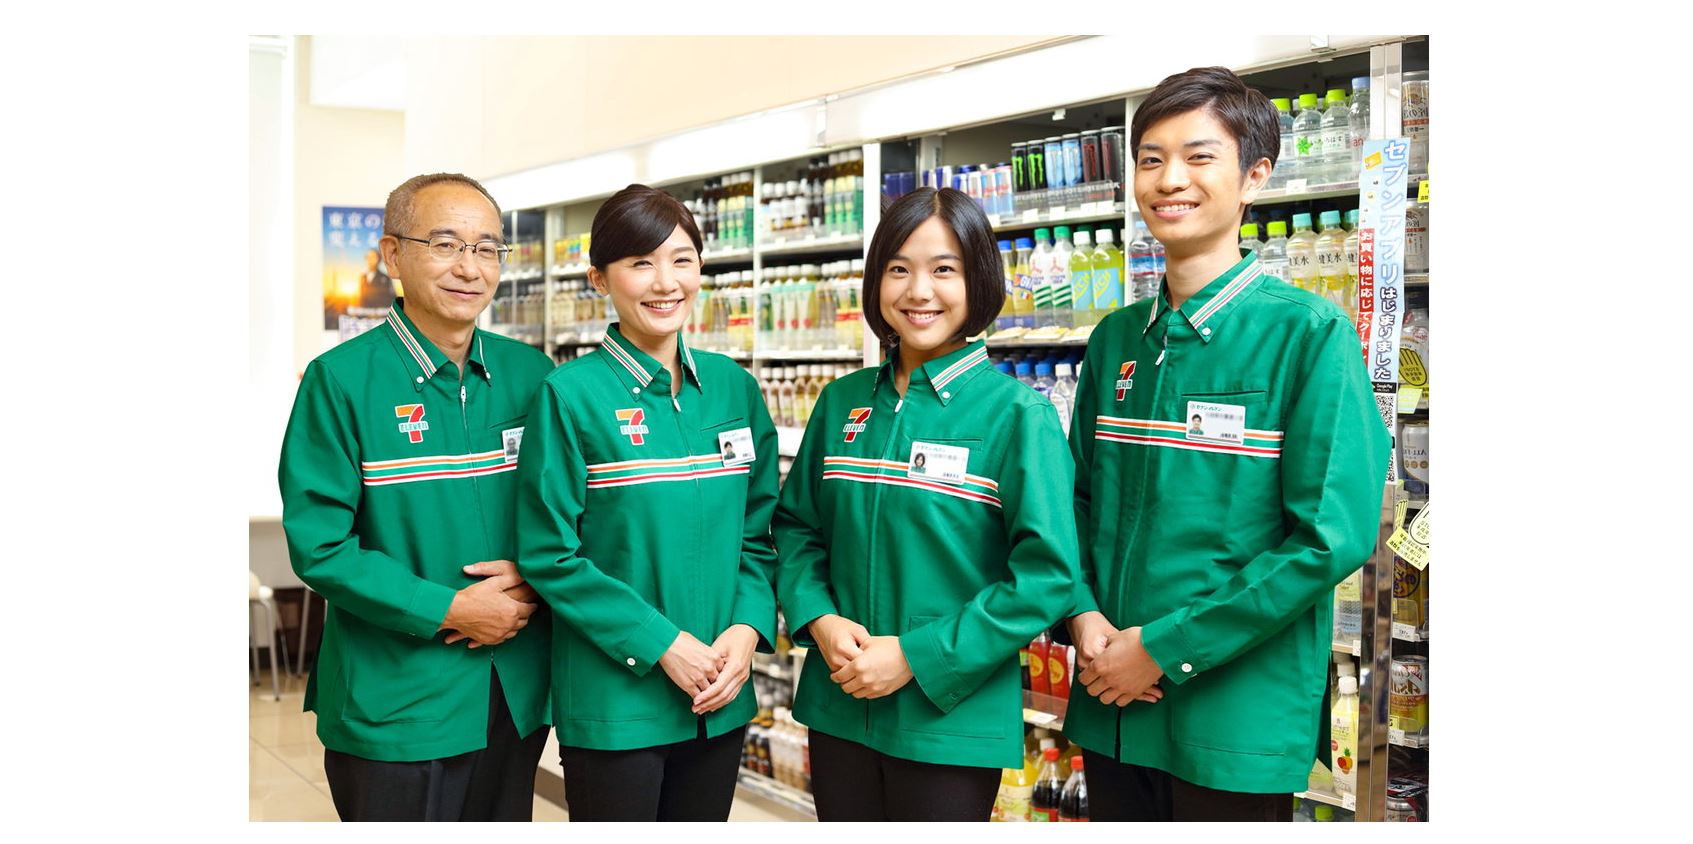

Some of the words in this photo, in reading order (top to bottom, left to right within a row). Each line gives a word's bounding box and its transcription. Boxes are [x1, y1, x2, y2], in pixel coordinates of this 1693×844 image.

[1117, 361, 1136, 401] 7
[395, 404, 425, 443] 7
[616, 408, 645, 444] 7
[844, 408, 872, 442] 7
